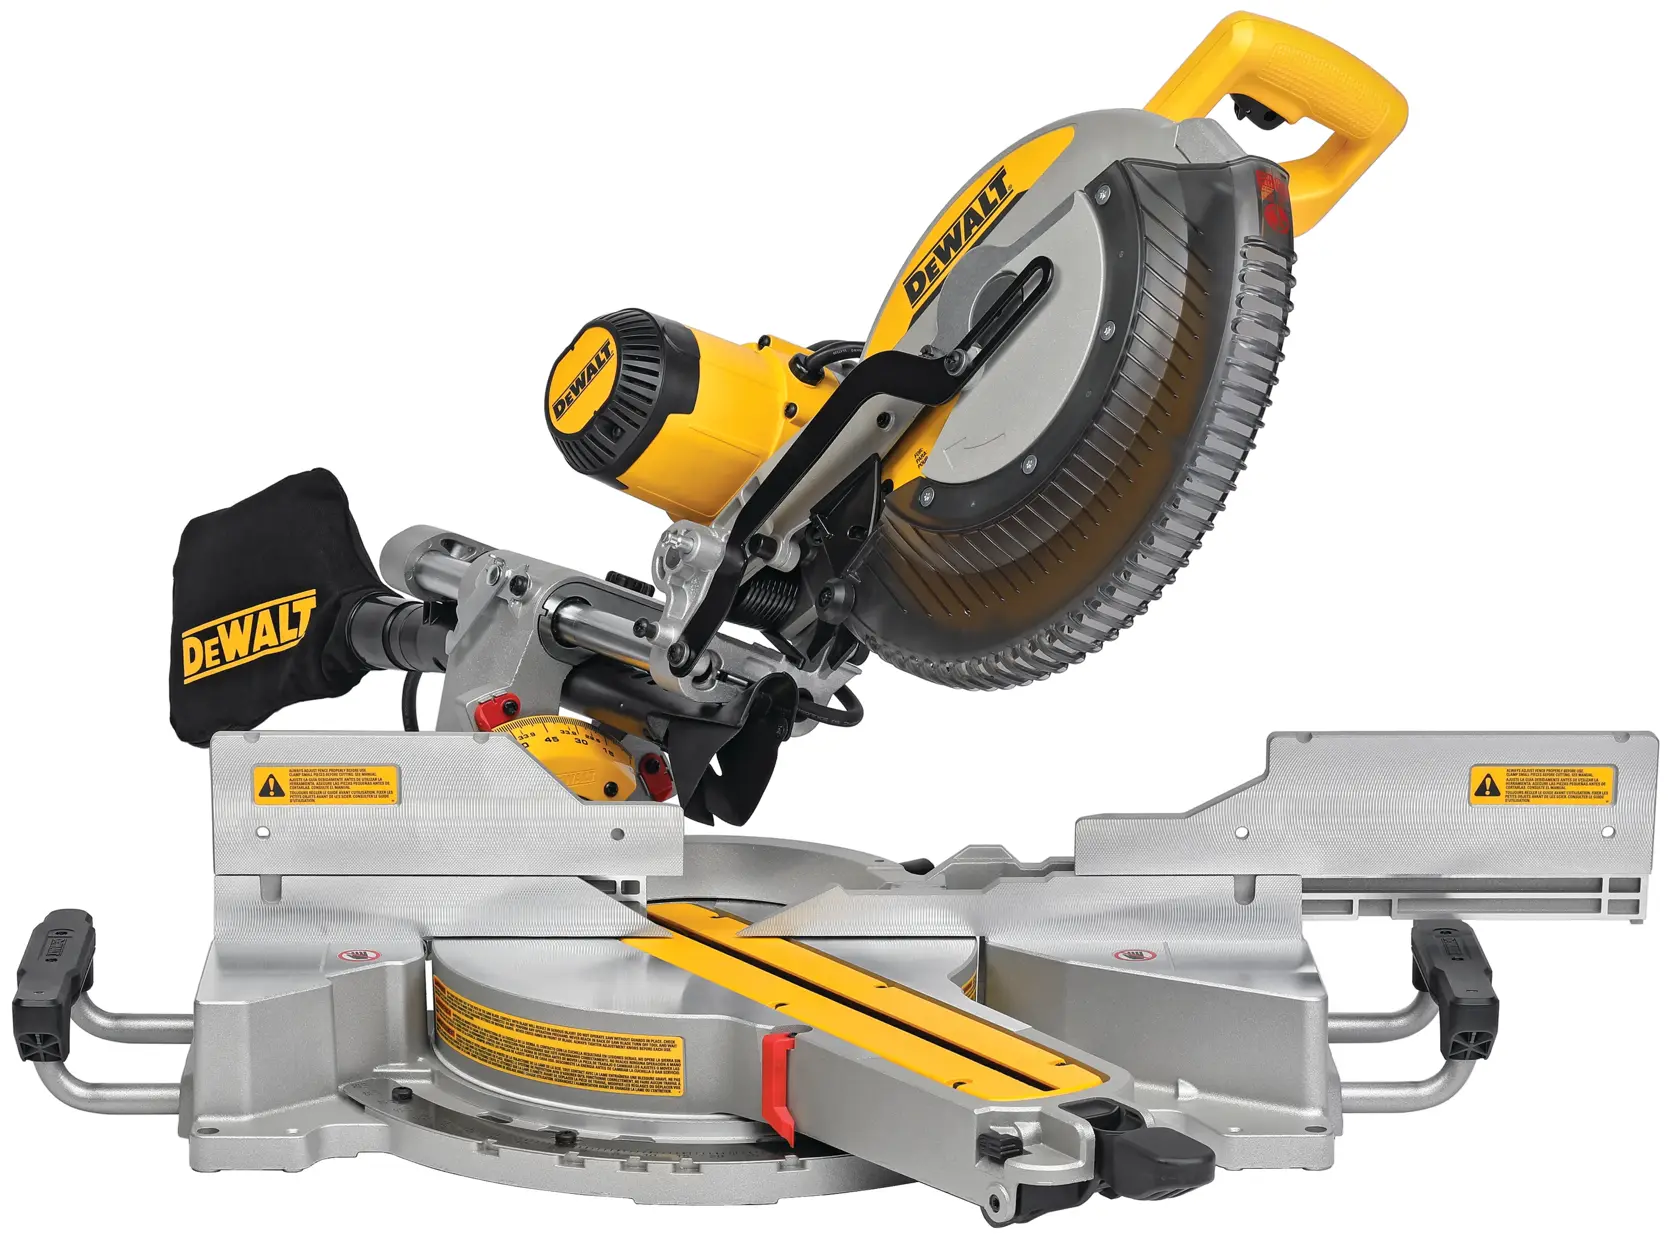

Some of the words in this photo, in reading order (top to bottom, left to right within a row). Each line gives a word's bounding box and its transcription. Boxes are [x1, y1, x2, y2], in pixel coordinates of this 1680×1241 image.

[903, 168, 1008, 305] DEWALT
[552, 340, 612, 420] DEWALT
[182, 595, 317, 678] DEWALT
